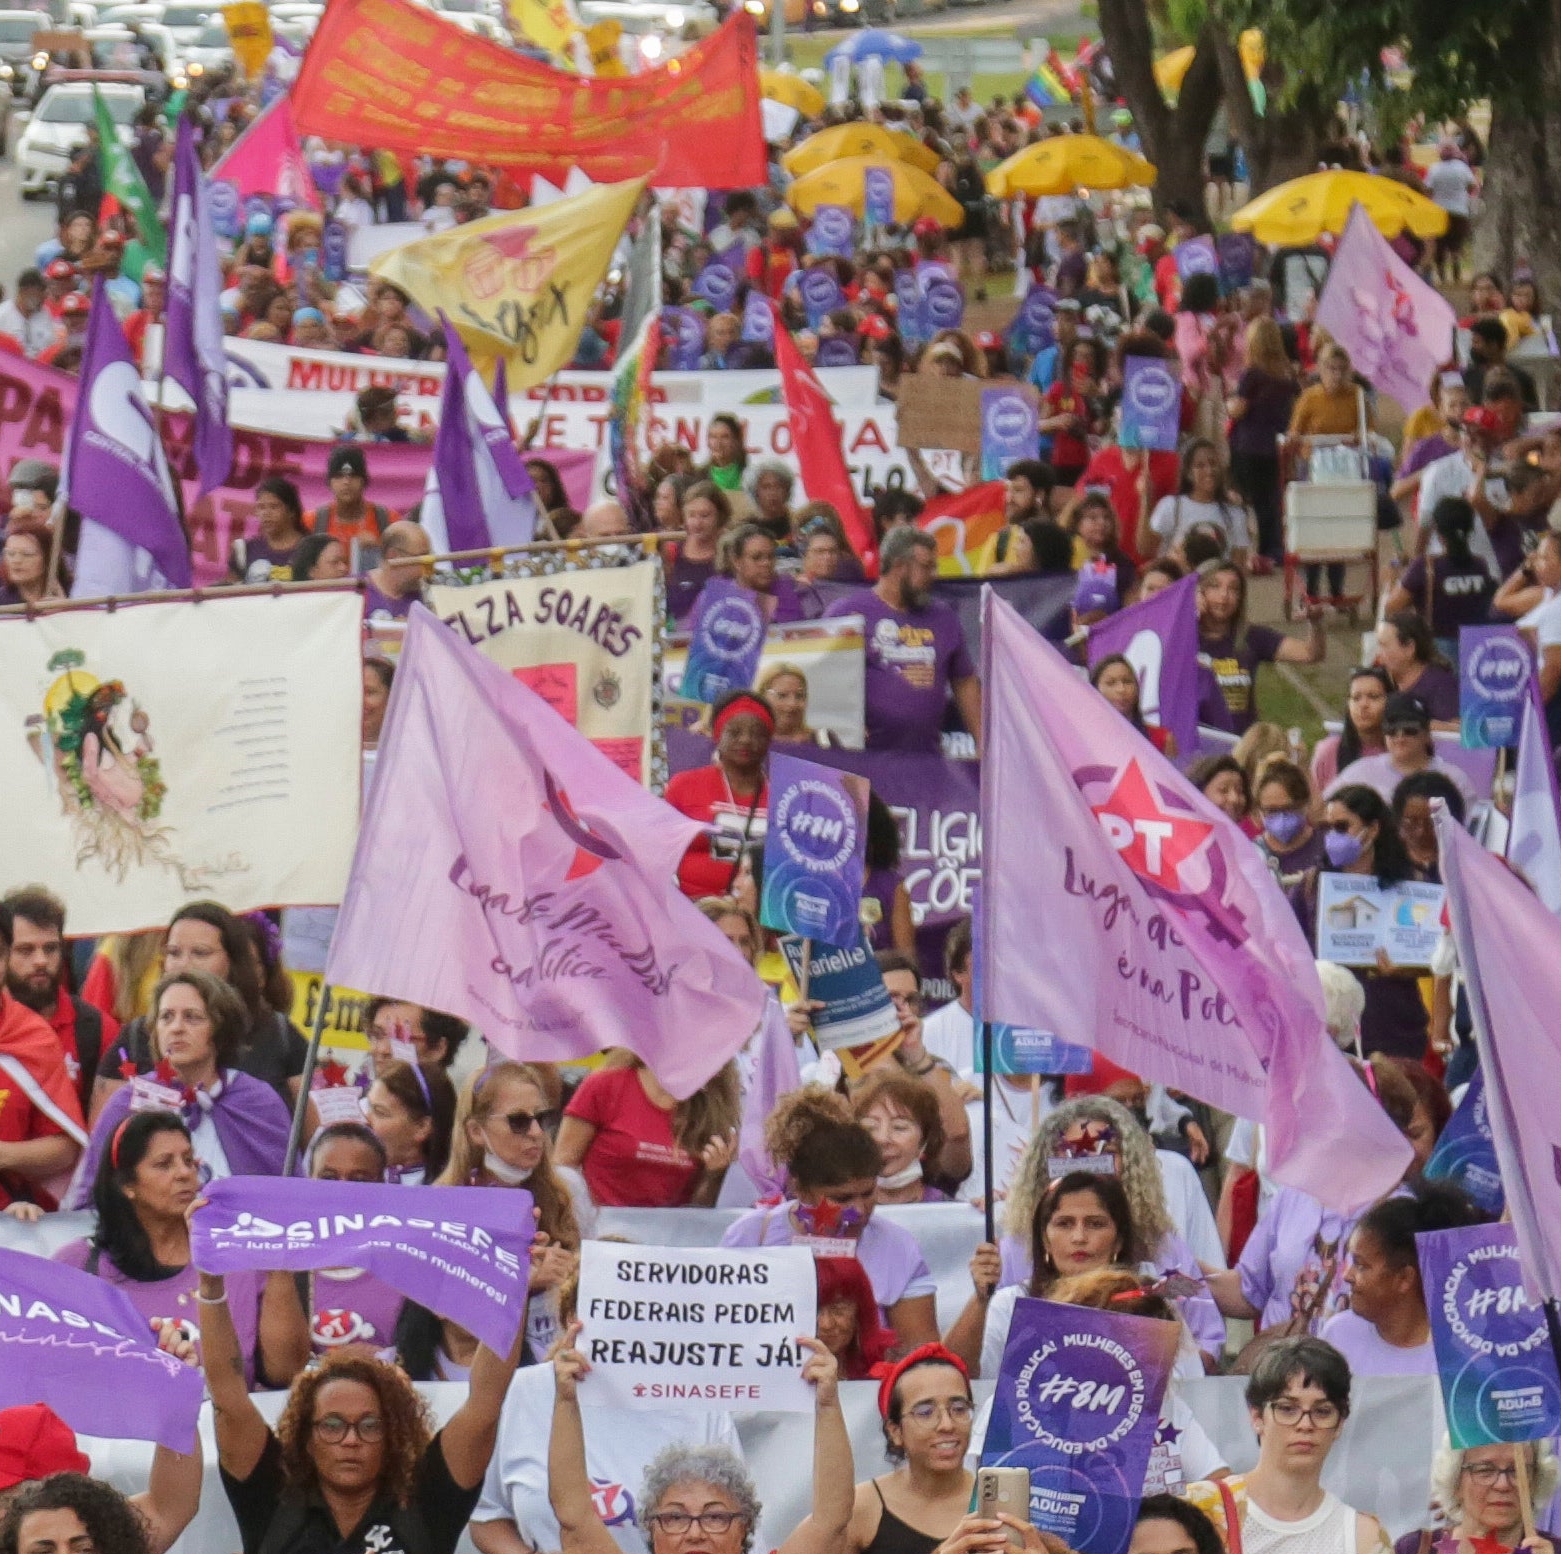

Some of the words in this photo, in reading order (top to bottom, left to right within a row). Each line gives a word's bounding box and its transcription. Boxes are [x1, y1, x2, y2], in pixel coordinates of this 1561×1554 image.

[589, 413, 887, 456] TCNLOIA
[533, 587, 644, 658] SOARES
[1097, 812, 1174, 876] PT
[1468, 1244, 1521, 1265] MULHE
[395, 1241, 428, 1261] das
[430, 1256, 509, 1307] mulheres!
[616, 1259, 770, 1287] SERVIDORAS
[589, 1297, 708, 1326] FEDERAIS
[714, 1299, 796, 1325] PEDEM
[1443, 1261, 1494, 1354] DEMOCRACIA!
[590, 1337, 742, 1368] REAJUSTE
[750, 1332, 804, 1368] JÁ!
[1063, 1334, 1137, 1371] MULHERES
[1495, 1343, 1519, 1357] DA
[1015, 1340, 1058, 1399] PÚBLICA!
[1127, 1369, 1145, 1392] EM
[649, 1382, 763, 1400] SINASEFE
[1039, 1373, 1126, 1415] #8M
[1497, 1397, 1542, 1411] ADUnB
[1018, 1401, 1083, 1454] EDUCAÇÃO
[1106, 1393, 1145, 1442] DEFESA
[1088, 1439, 1108, 1453] DA
[1029, 1497, 1080, 1516] ADUnB
